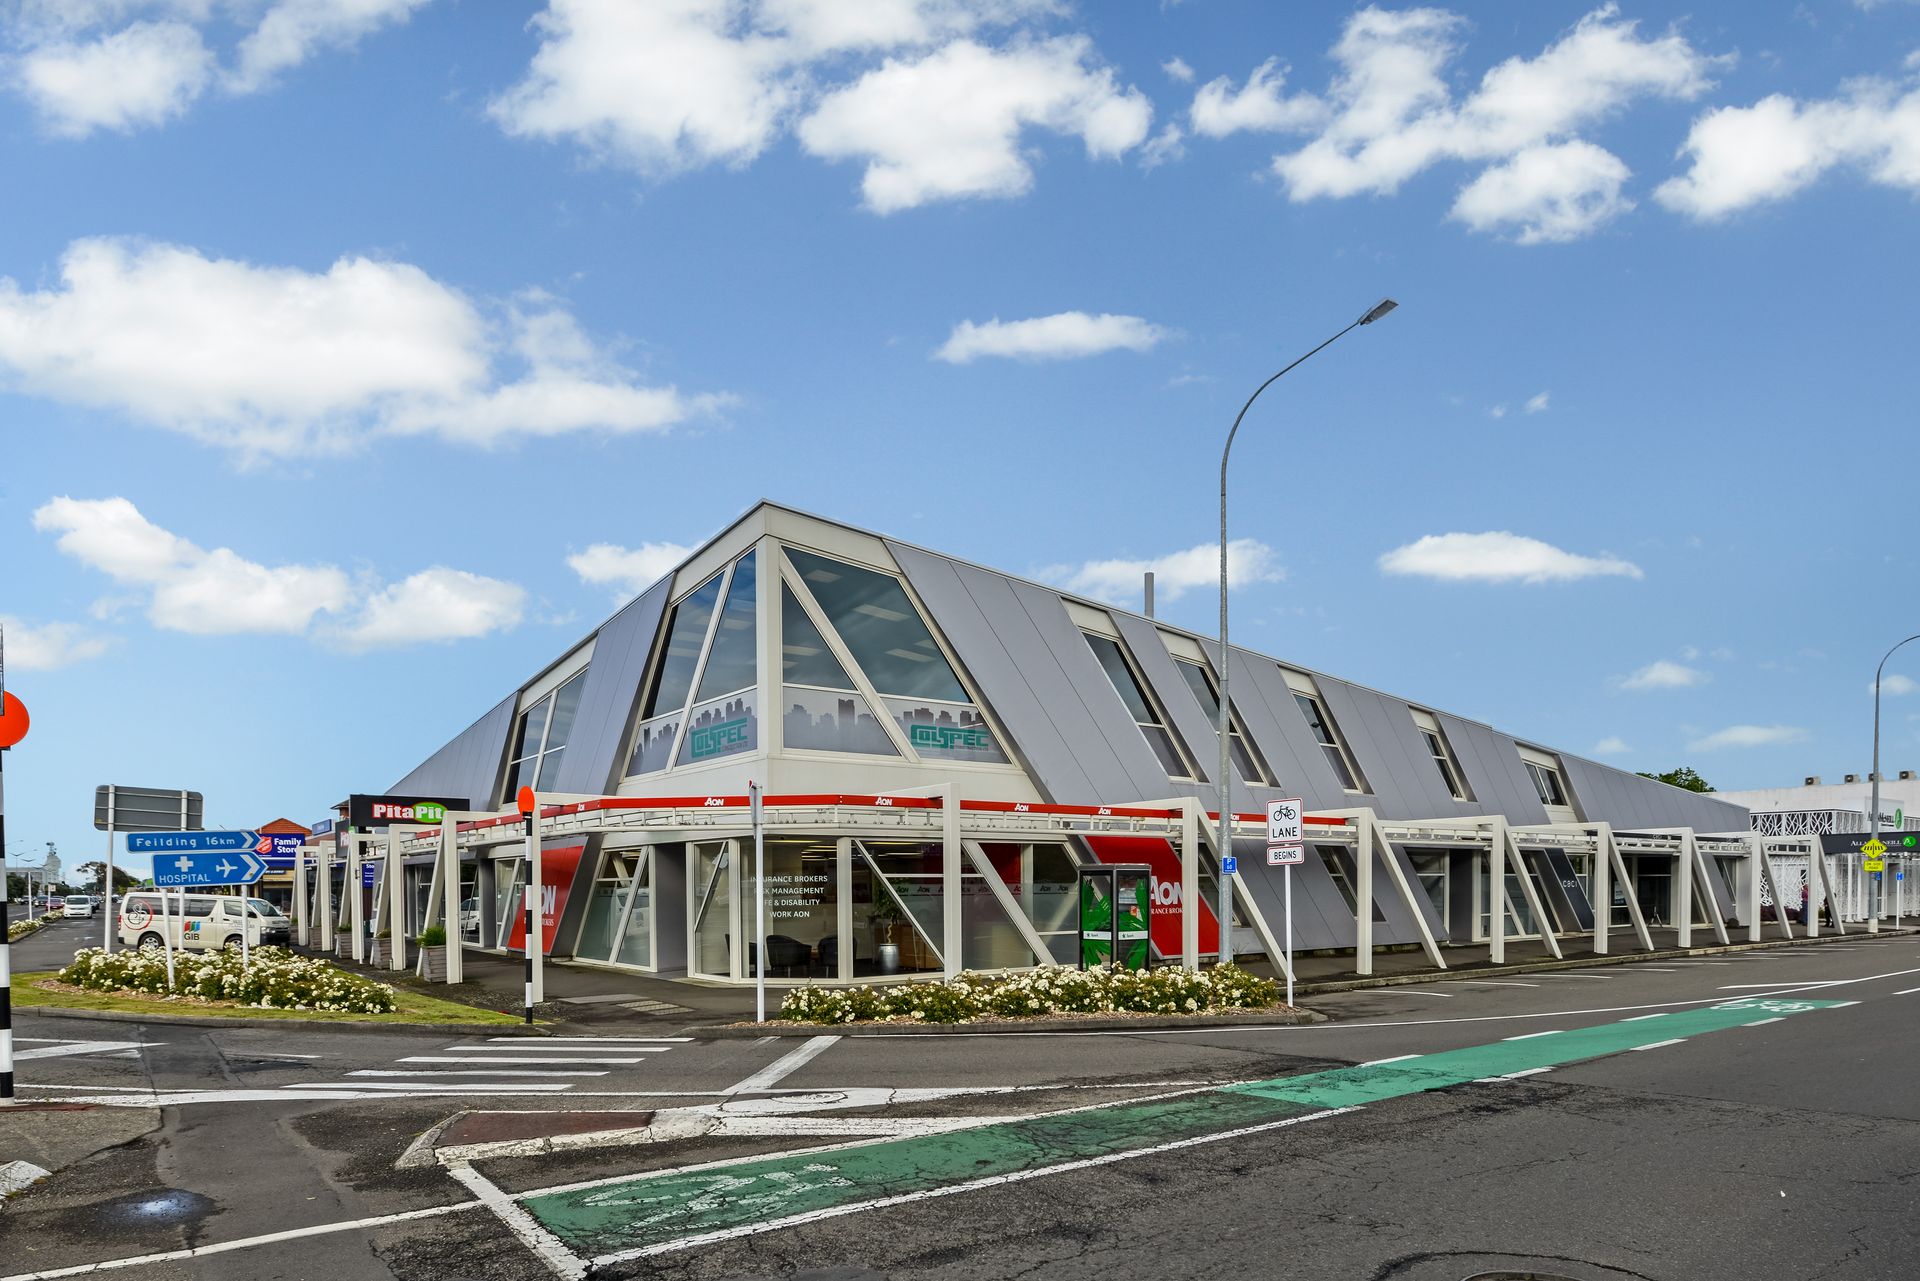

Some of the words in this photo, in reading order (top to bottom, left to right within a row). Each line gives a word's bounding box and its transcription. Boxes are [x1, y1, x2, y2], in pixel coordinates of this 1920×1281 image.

[704, 797, 724, 806] AON
[875, 797, 893, 806] AON
[1014, 803, 1029, 812] AON
[1098, 807, 1112, 815] AON
[1272, 827, 1298, 838] LANE
[136, 838, 197, 847] Feilding
[274, 838, 301, 847] Family
[1273, 851, 1297, 860] BEGINS
[158, 874, 211, 884] HOSPITAL
[771, 887, 825, 895] MANAGEMENT
[184, 932, 200, 941] GIB
